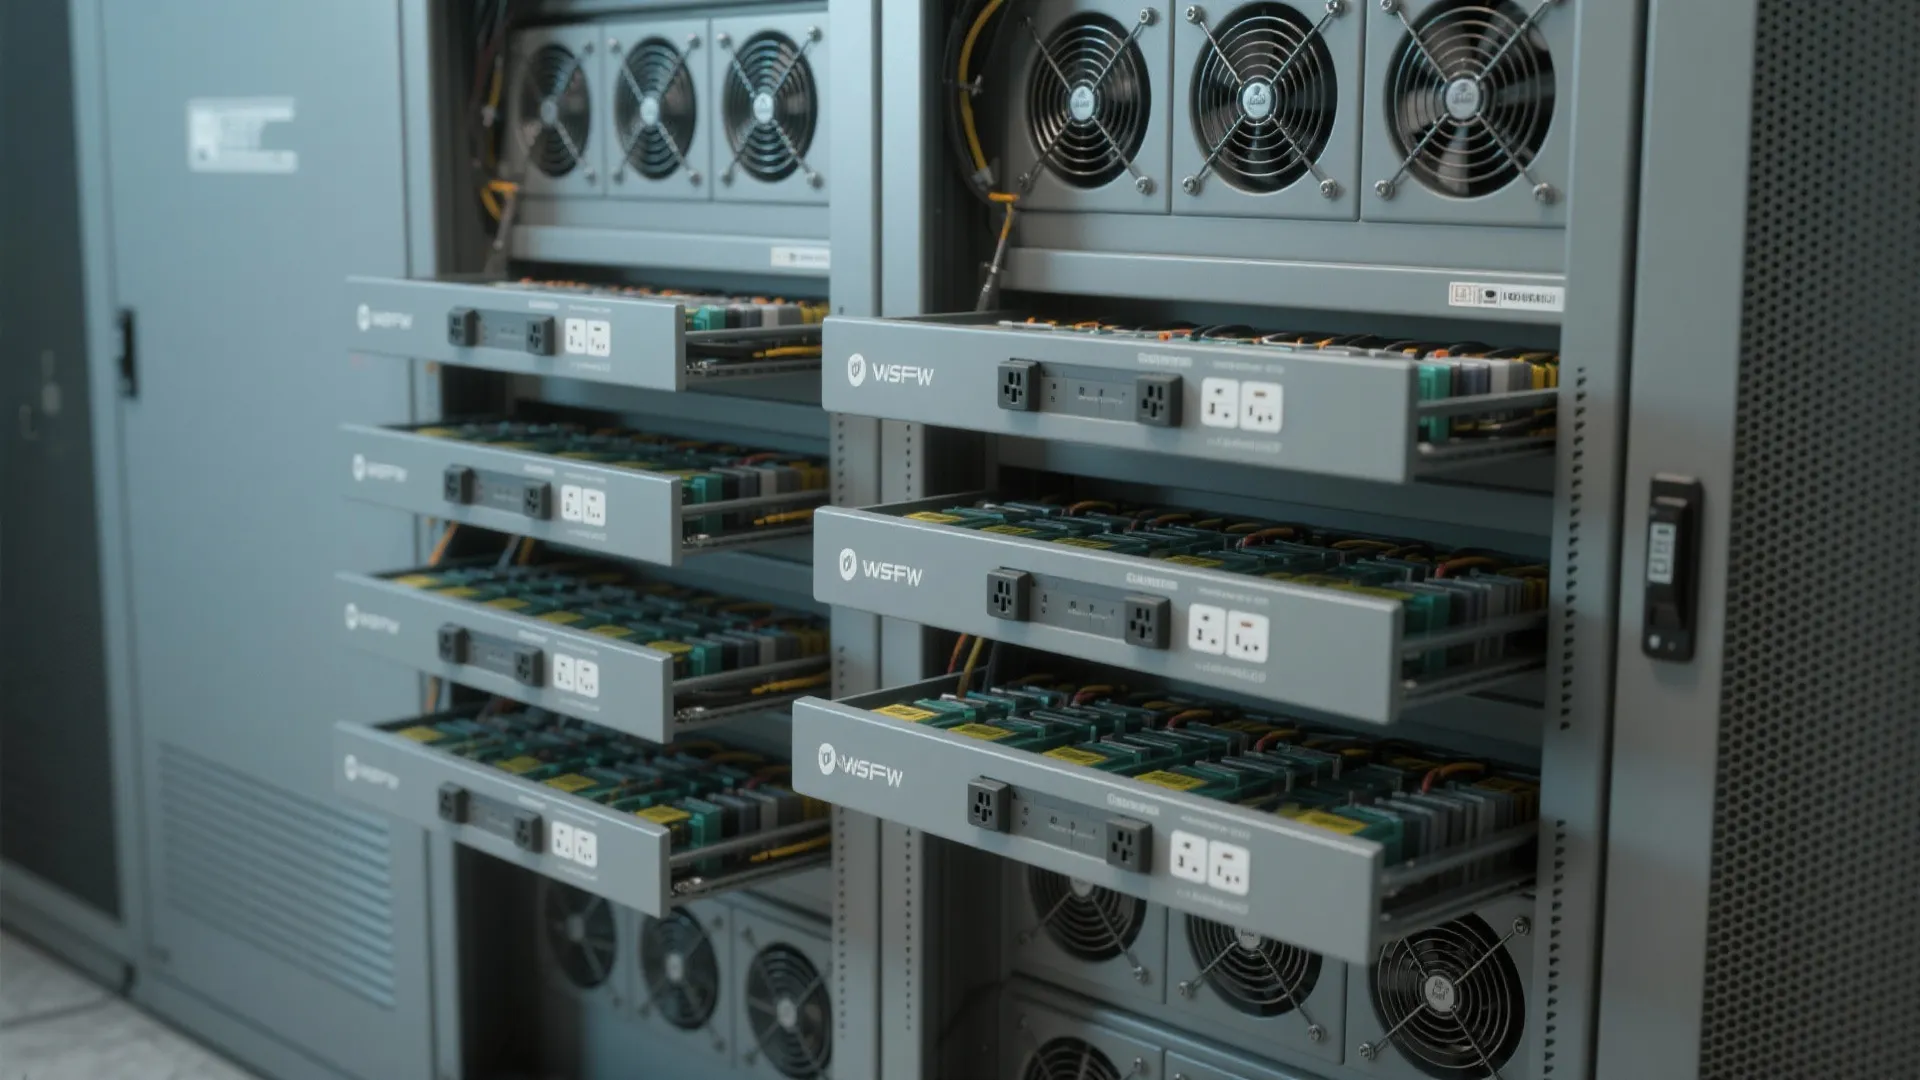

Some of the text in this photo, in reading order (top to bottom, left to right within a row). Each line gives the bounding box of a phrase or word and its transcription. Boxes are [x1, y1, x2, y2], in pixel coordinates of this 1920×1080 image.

[873, 362, 934, 386] WSFW
[863, 559, 923, 588] WSFW
[841, 753, 903, 789] WSFW
